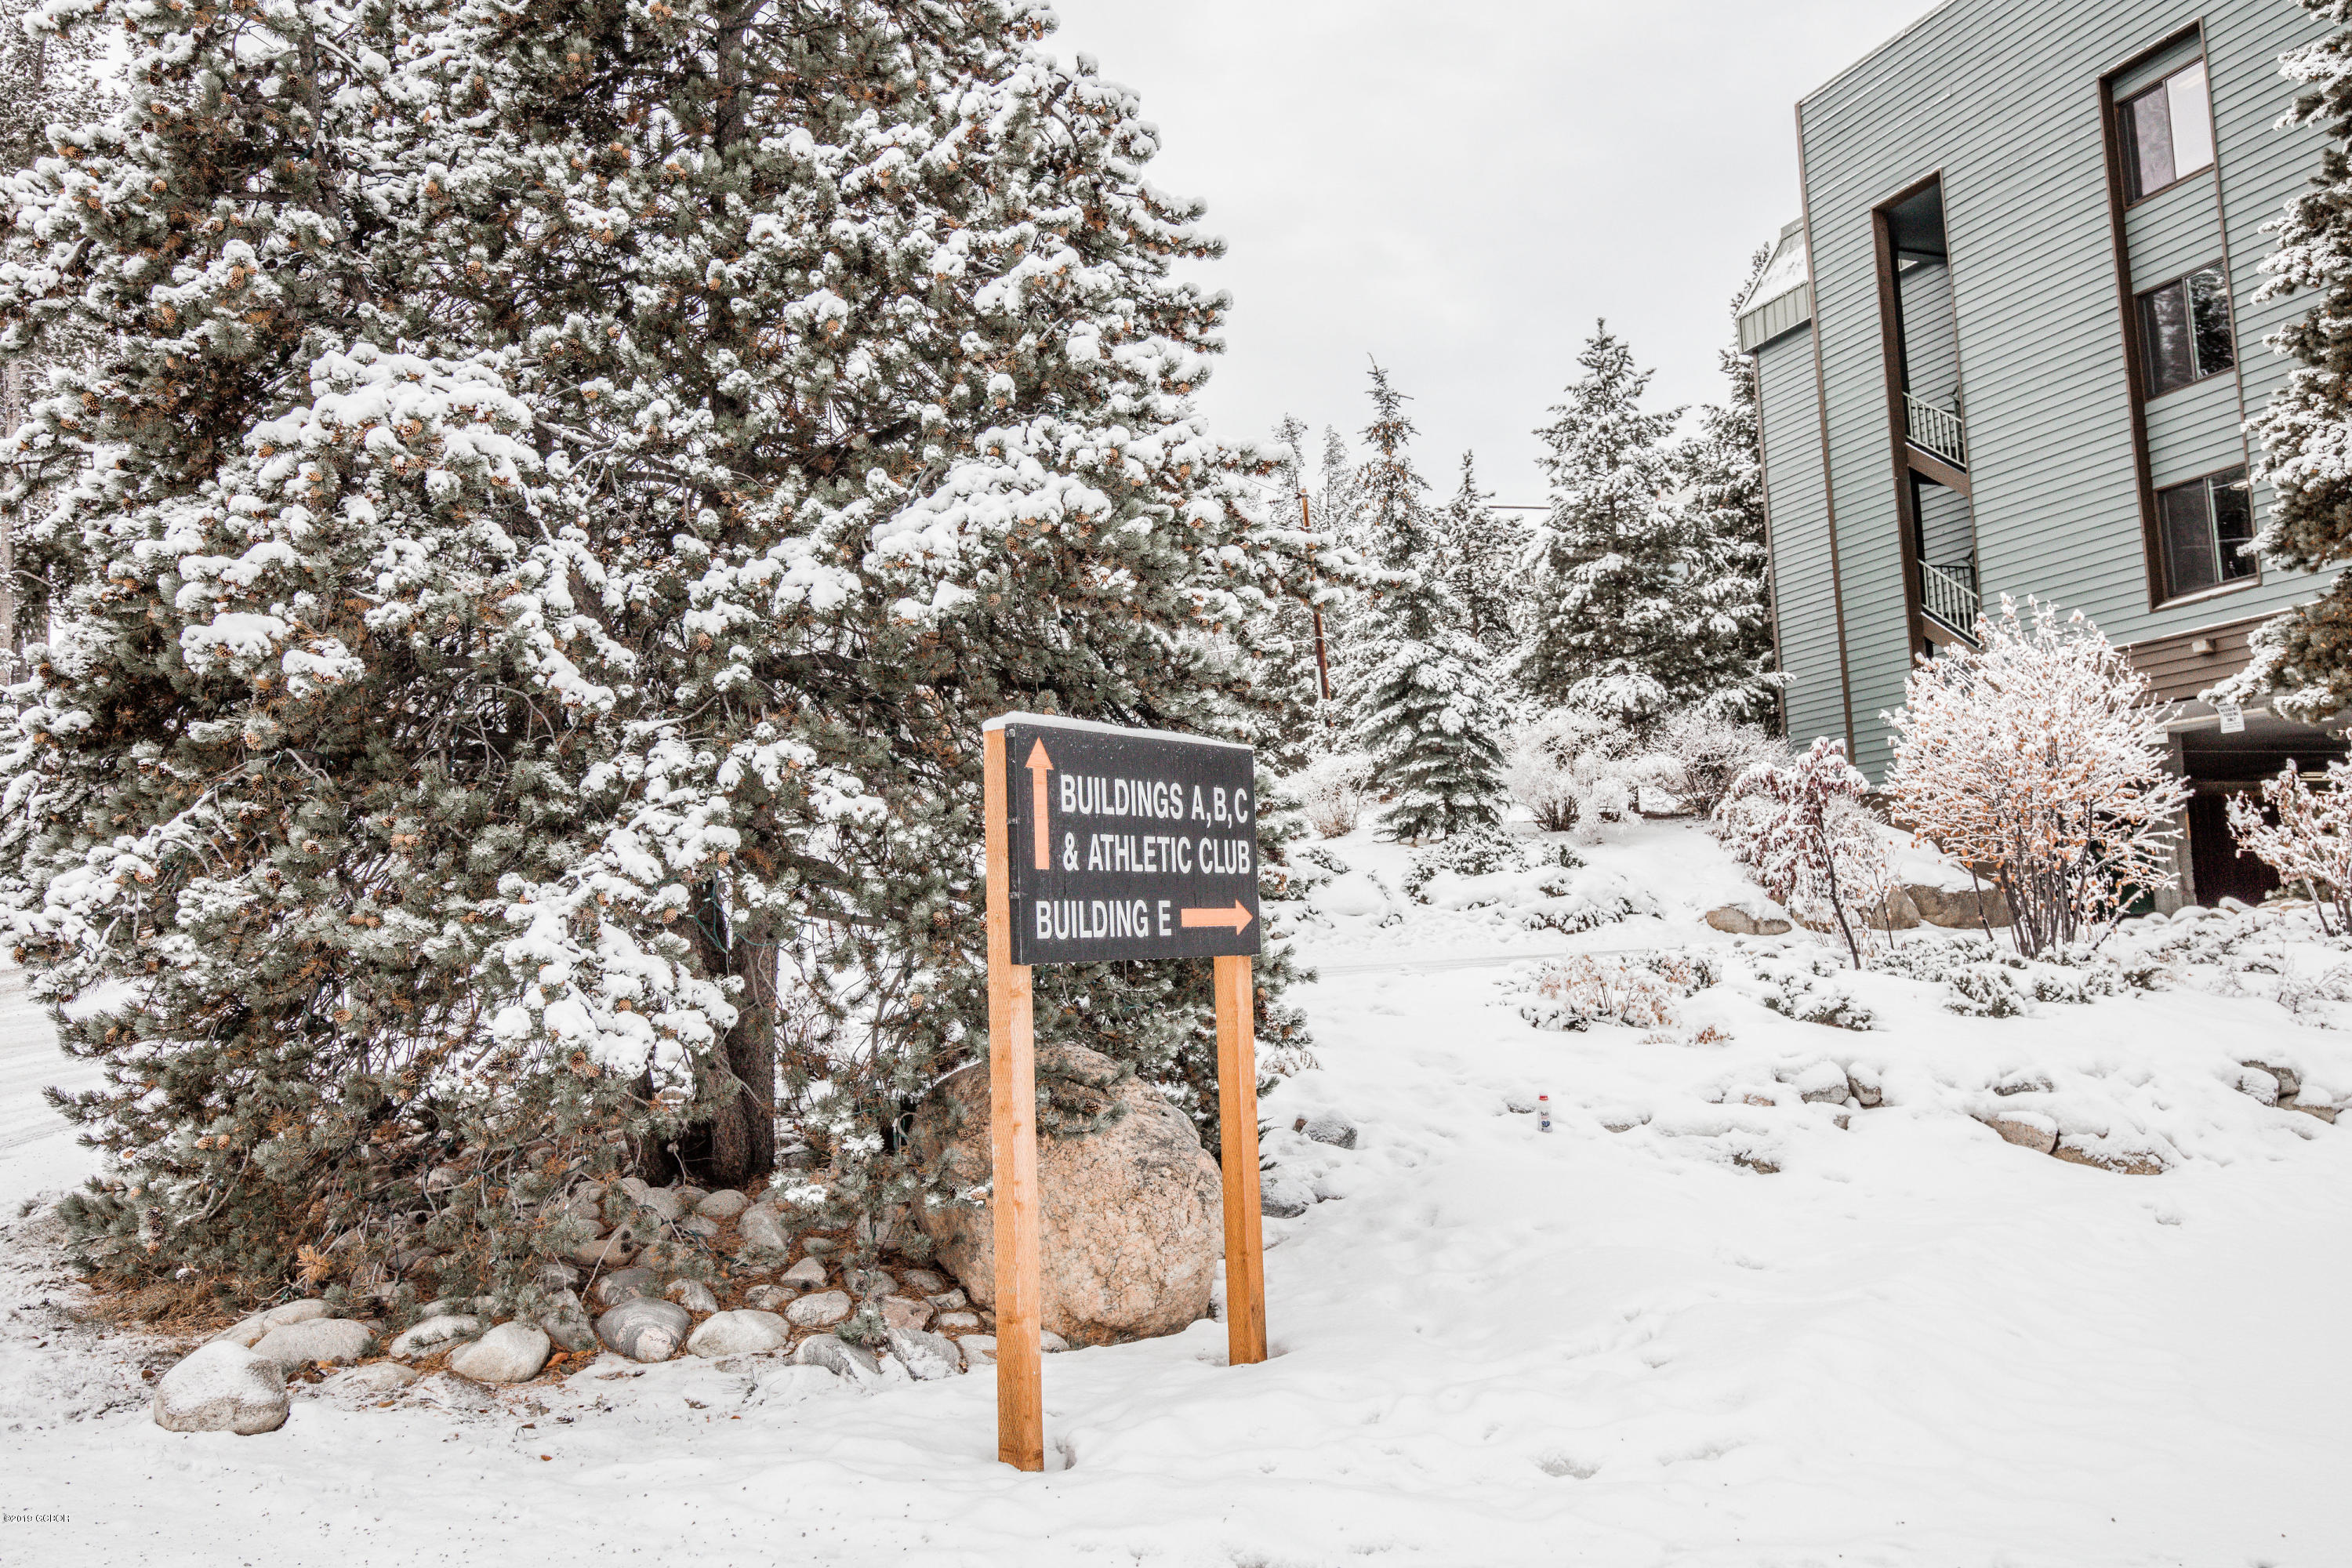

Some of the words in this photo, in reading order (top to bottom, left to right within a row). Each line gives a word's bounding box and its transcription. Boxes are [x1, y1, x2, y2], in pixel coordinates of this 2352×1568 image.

[1060, 773, 1183, 820] BUILDINGS
[1191, 786, 1249, 829] A,B,C
[1063, 832, 1079, 872] &
[1088, 833, 1192, 874] ATHLETIC
[1199, 837, 1250, 874] CLUB
[1036, 900, 1149, 940] BUILDING
[1158, 900, 1172, 937] E
